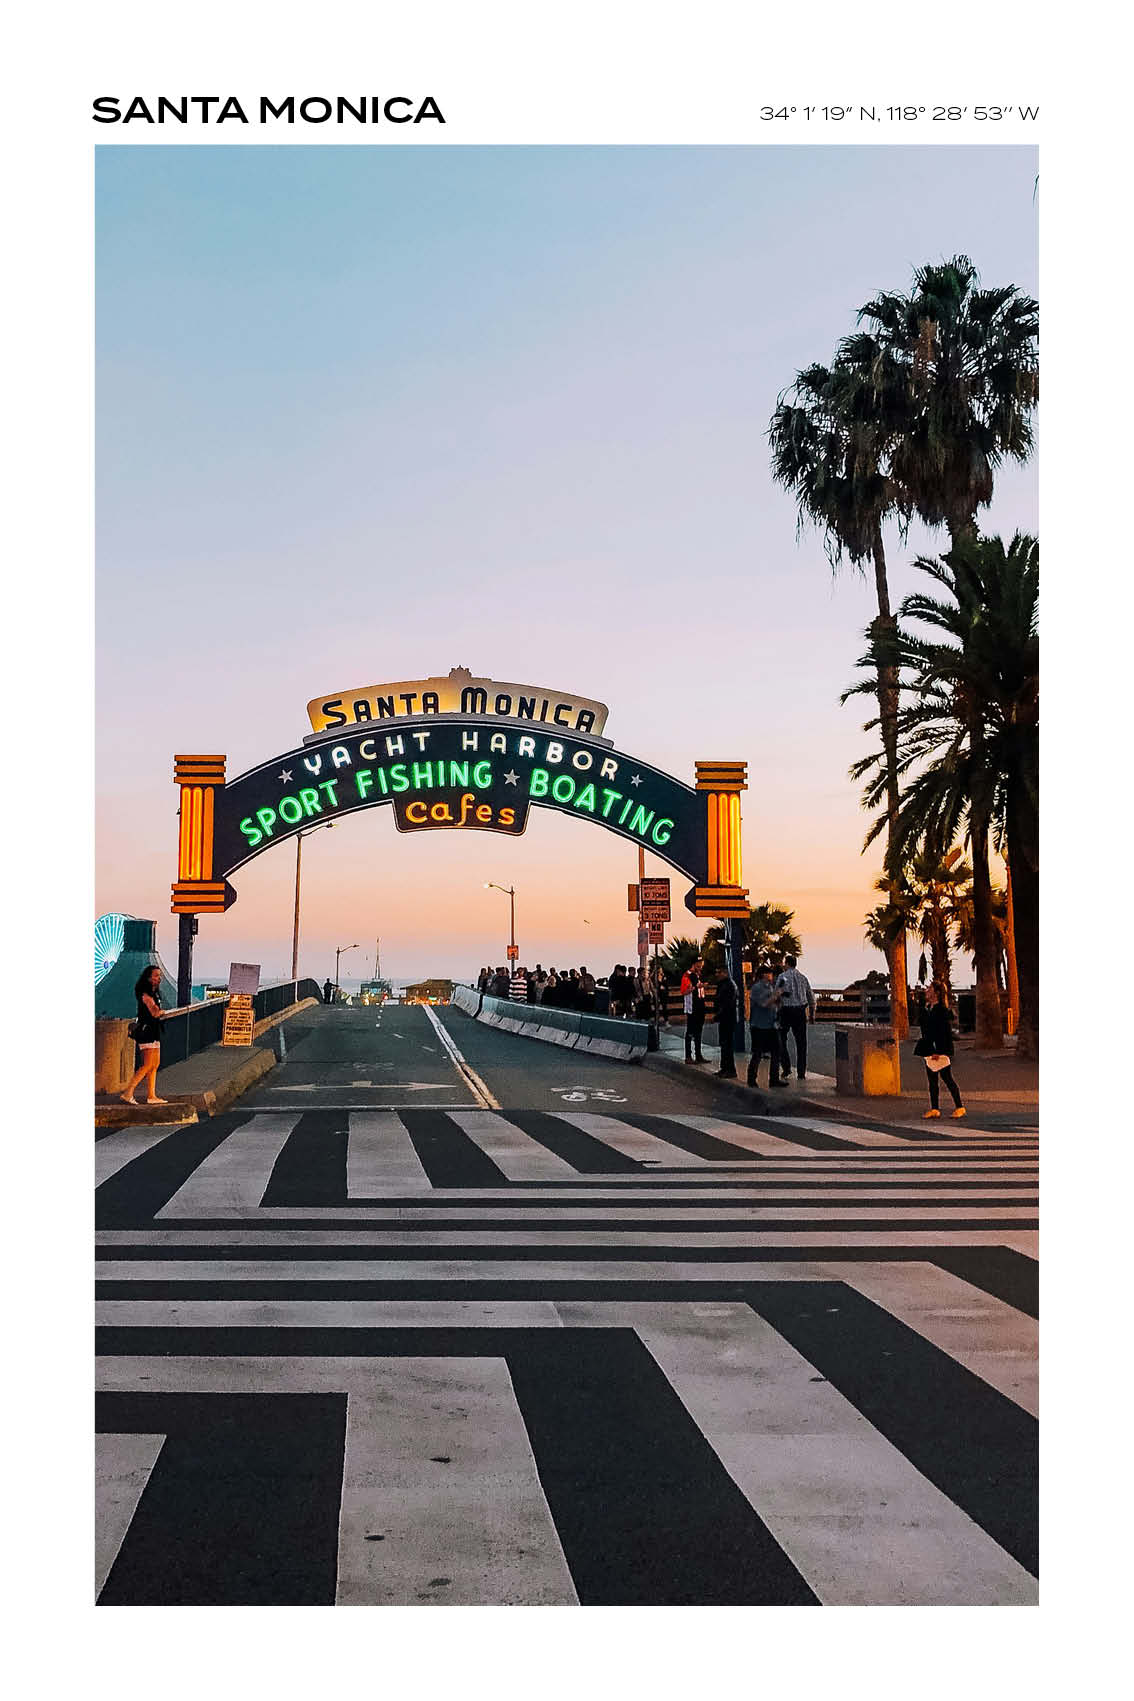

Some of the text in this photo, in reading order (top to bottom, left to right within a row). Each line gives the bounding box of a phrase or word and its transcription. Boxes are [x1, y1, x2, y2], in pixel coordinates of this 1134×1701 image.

[322, 687, 596, 733] SANTA MONICA
[303, 732, 619, 781] YACHT HARBOR
[239, 760, 675, 847] SPORT FISHING BOATING
[405, 793, 516, 827] cafes
